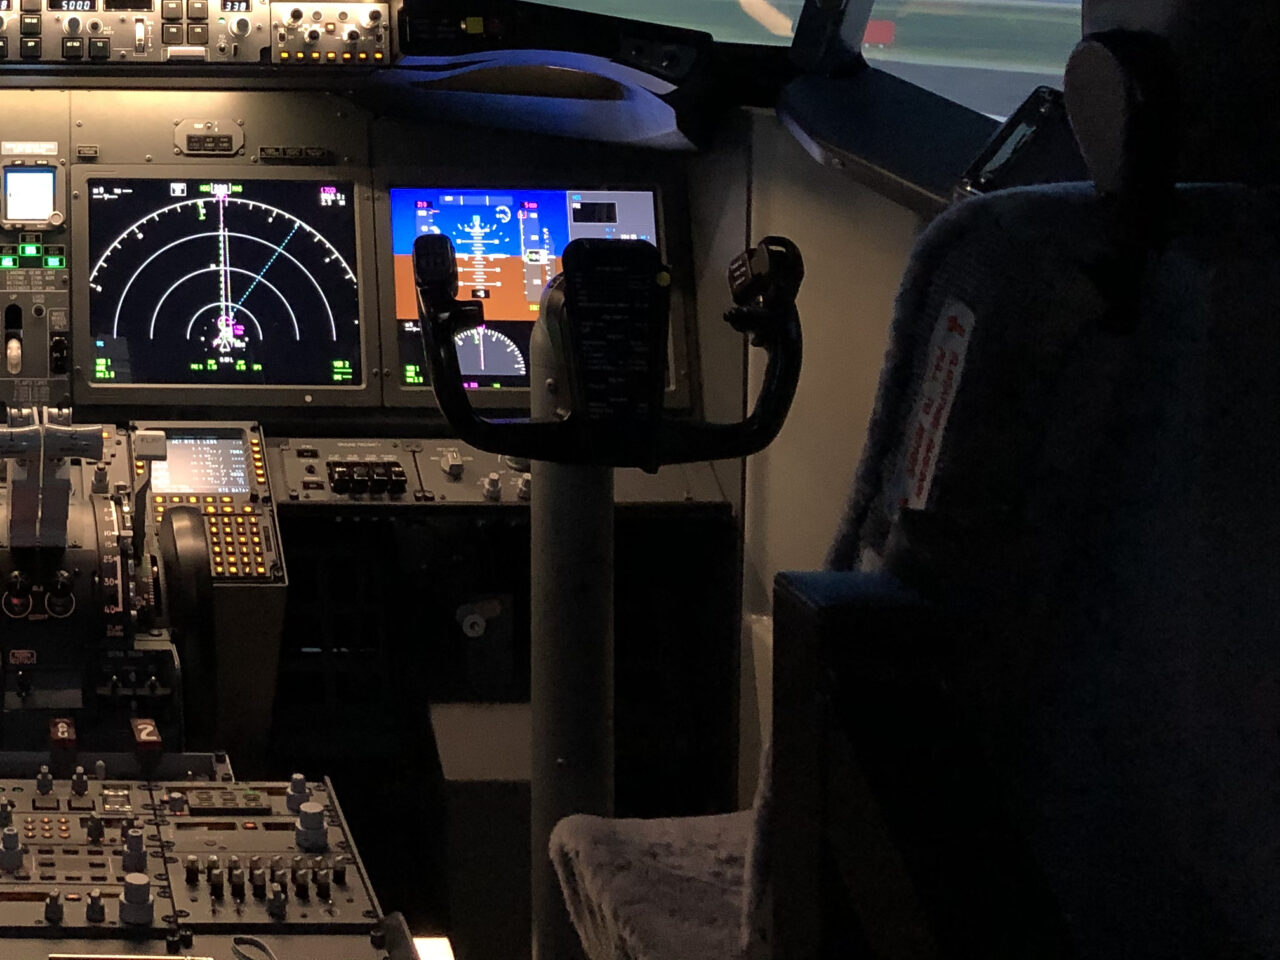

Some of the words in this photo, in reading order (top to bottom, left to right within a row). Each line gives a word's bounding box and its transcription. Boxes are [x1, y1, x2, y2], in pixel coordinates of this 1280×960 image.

[62, 1, 90, 10] 5000
[104, 605, 116, 614] 40
[137, 724, 158, 741] 2
